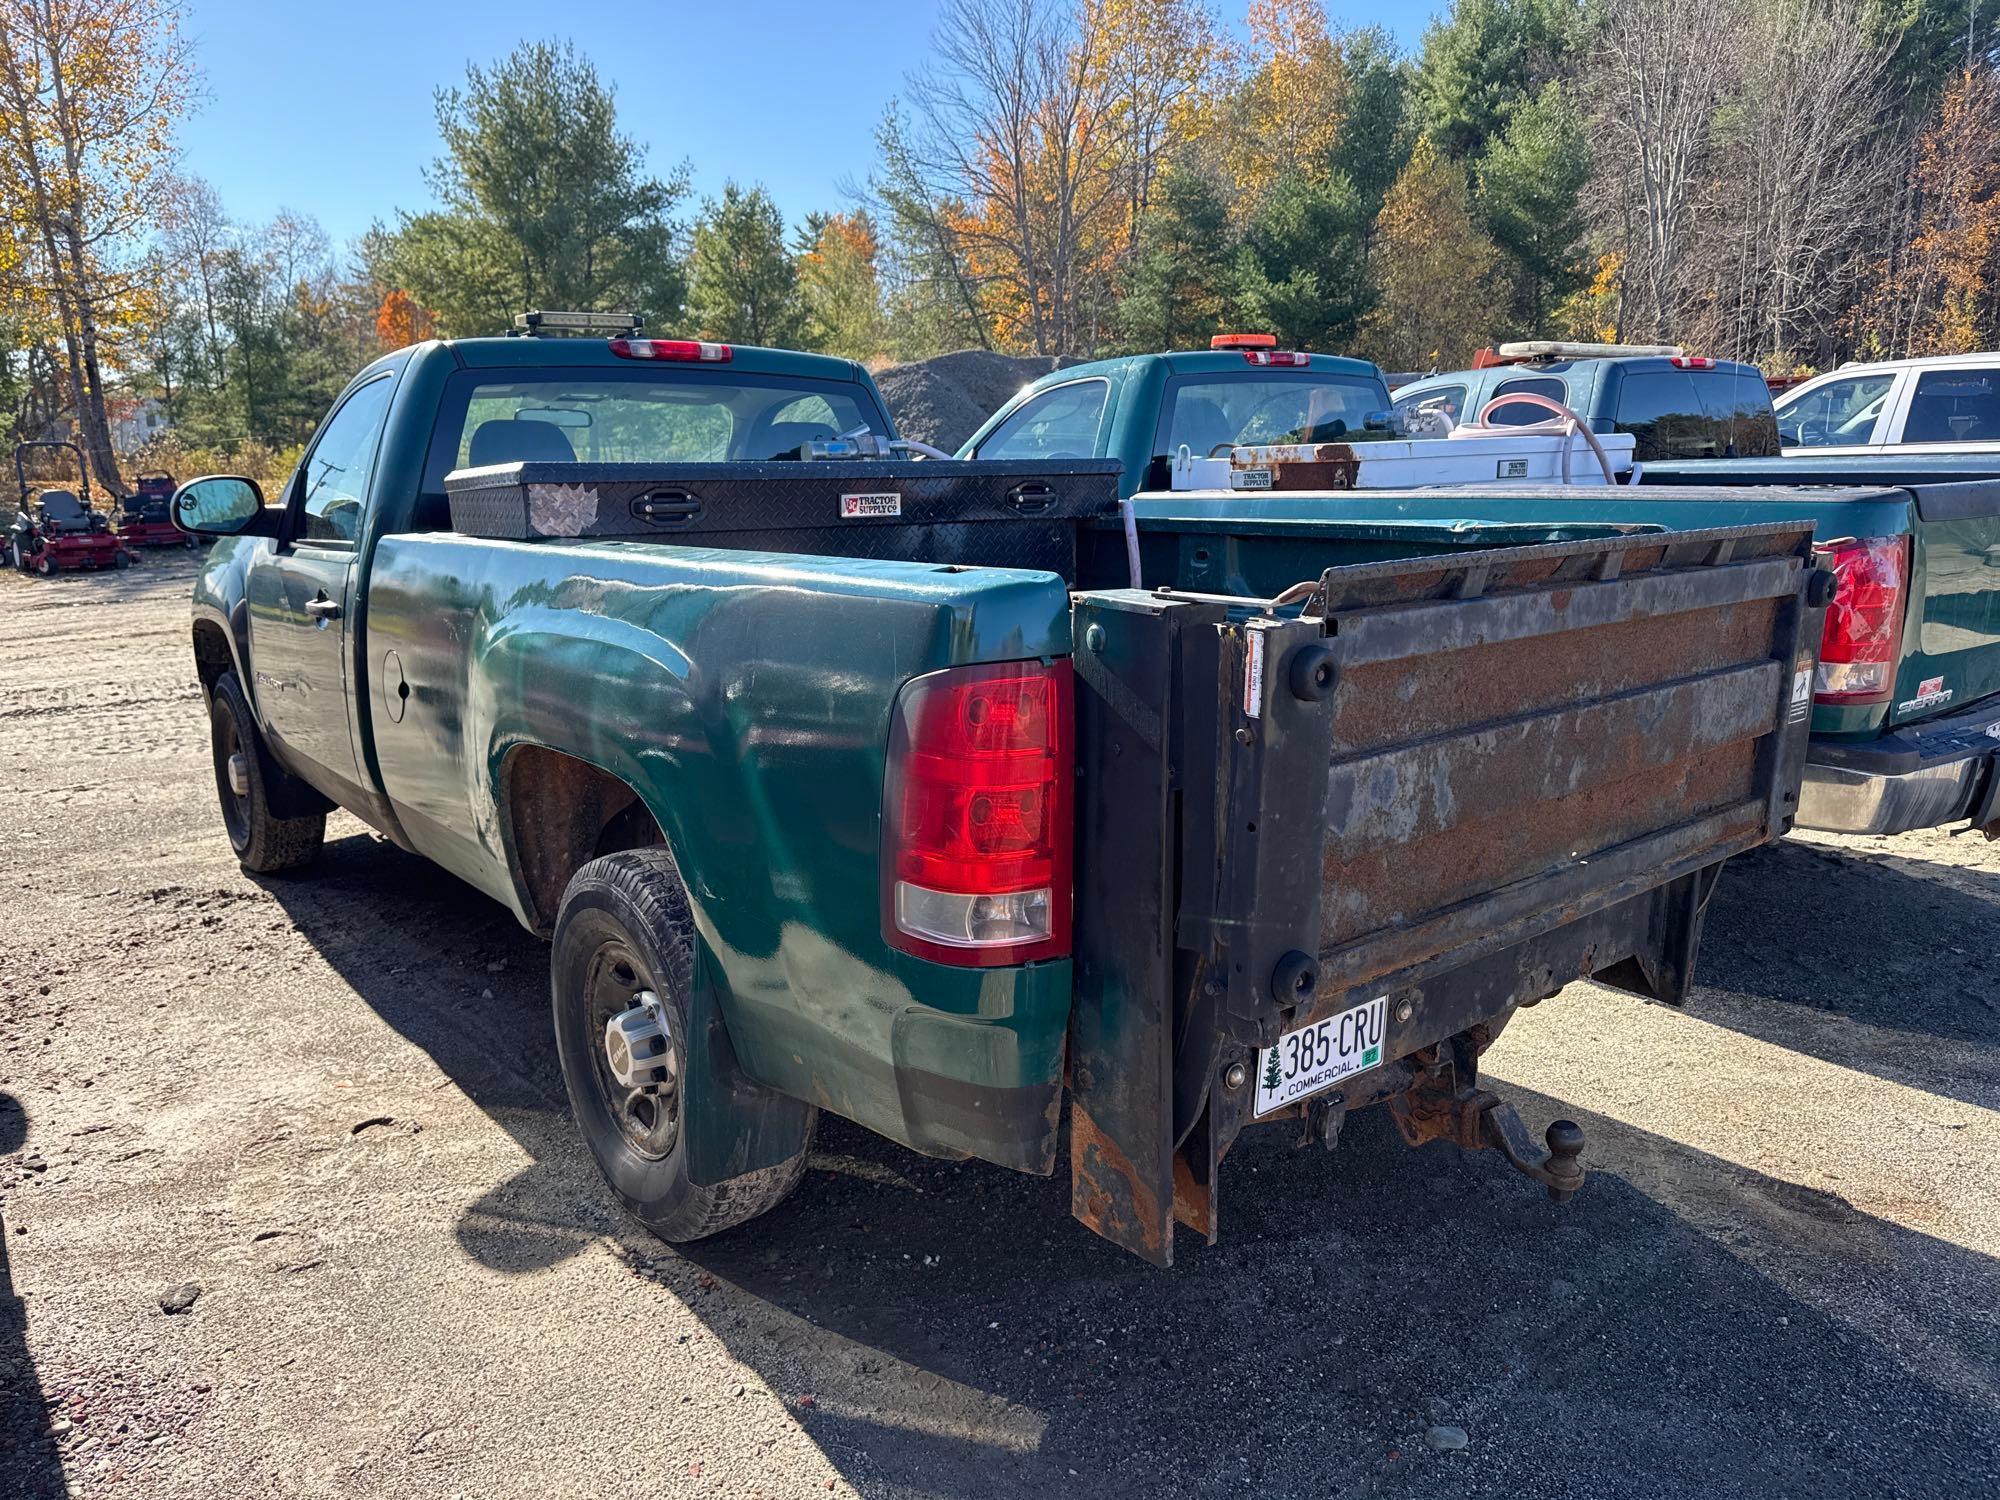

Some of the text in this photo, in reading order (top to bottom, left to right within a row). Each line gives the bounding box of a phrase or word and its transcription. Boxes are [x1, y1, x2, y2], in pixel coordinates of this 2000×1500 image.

[859, 496, 897, 505] TRACTOR
[859, 505, 886, 514] SUPPLY
[1897, 689, 1953, 716] SIERRA
[613, 1042, 627, 1064] GMC
[1288, 1060, 1354, 1096] COMMERCIAL
